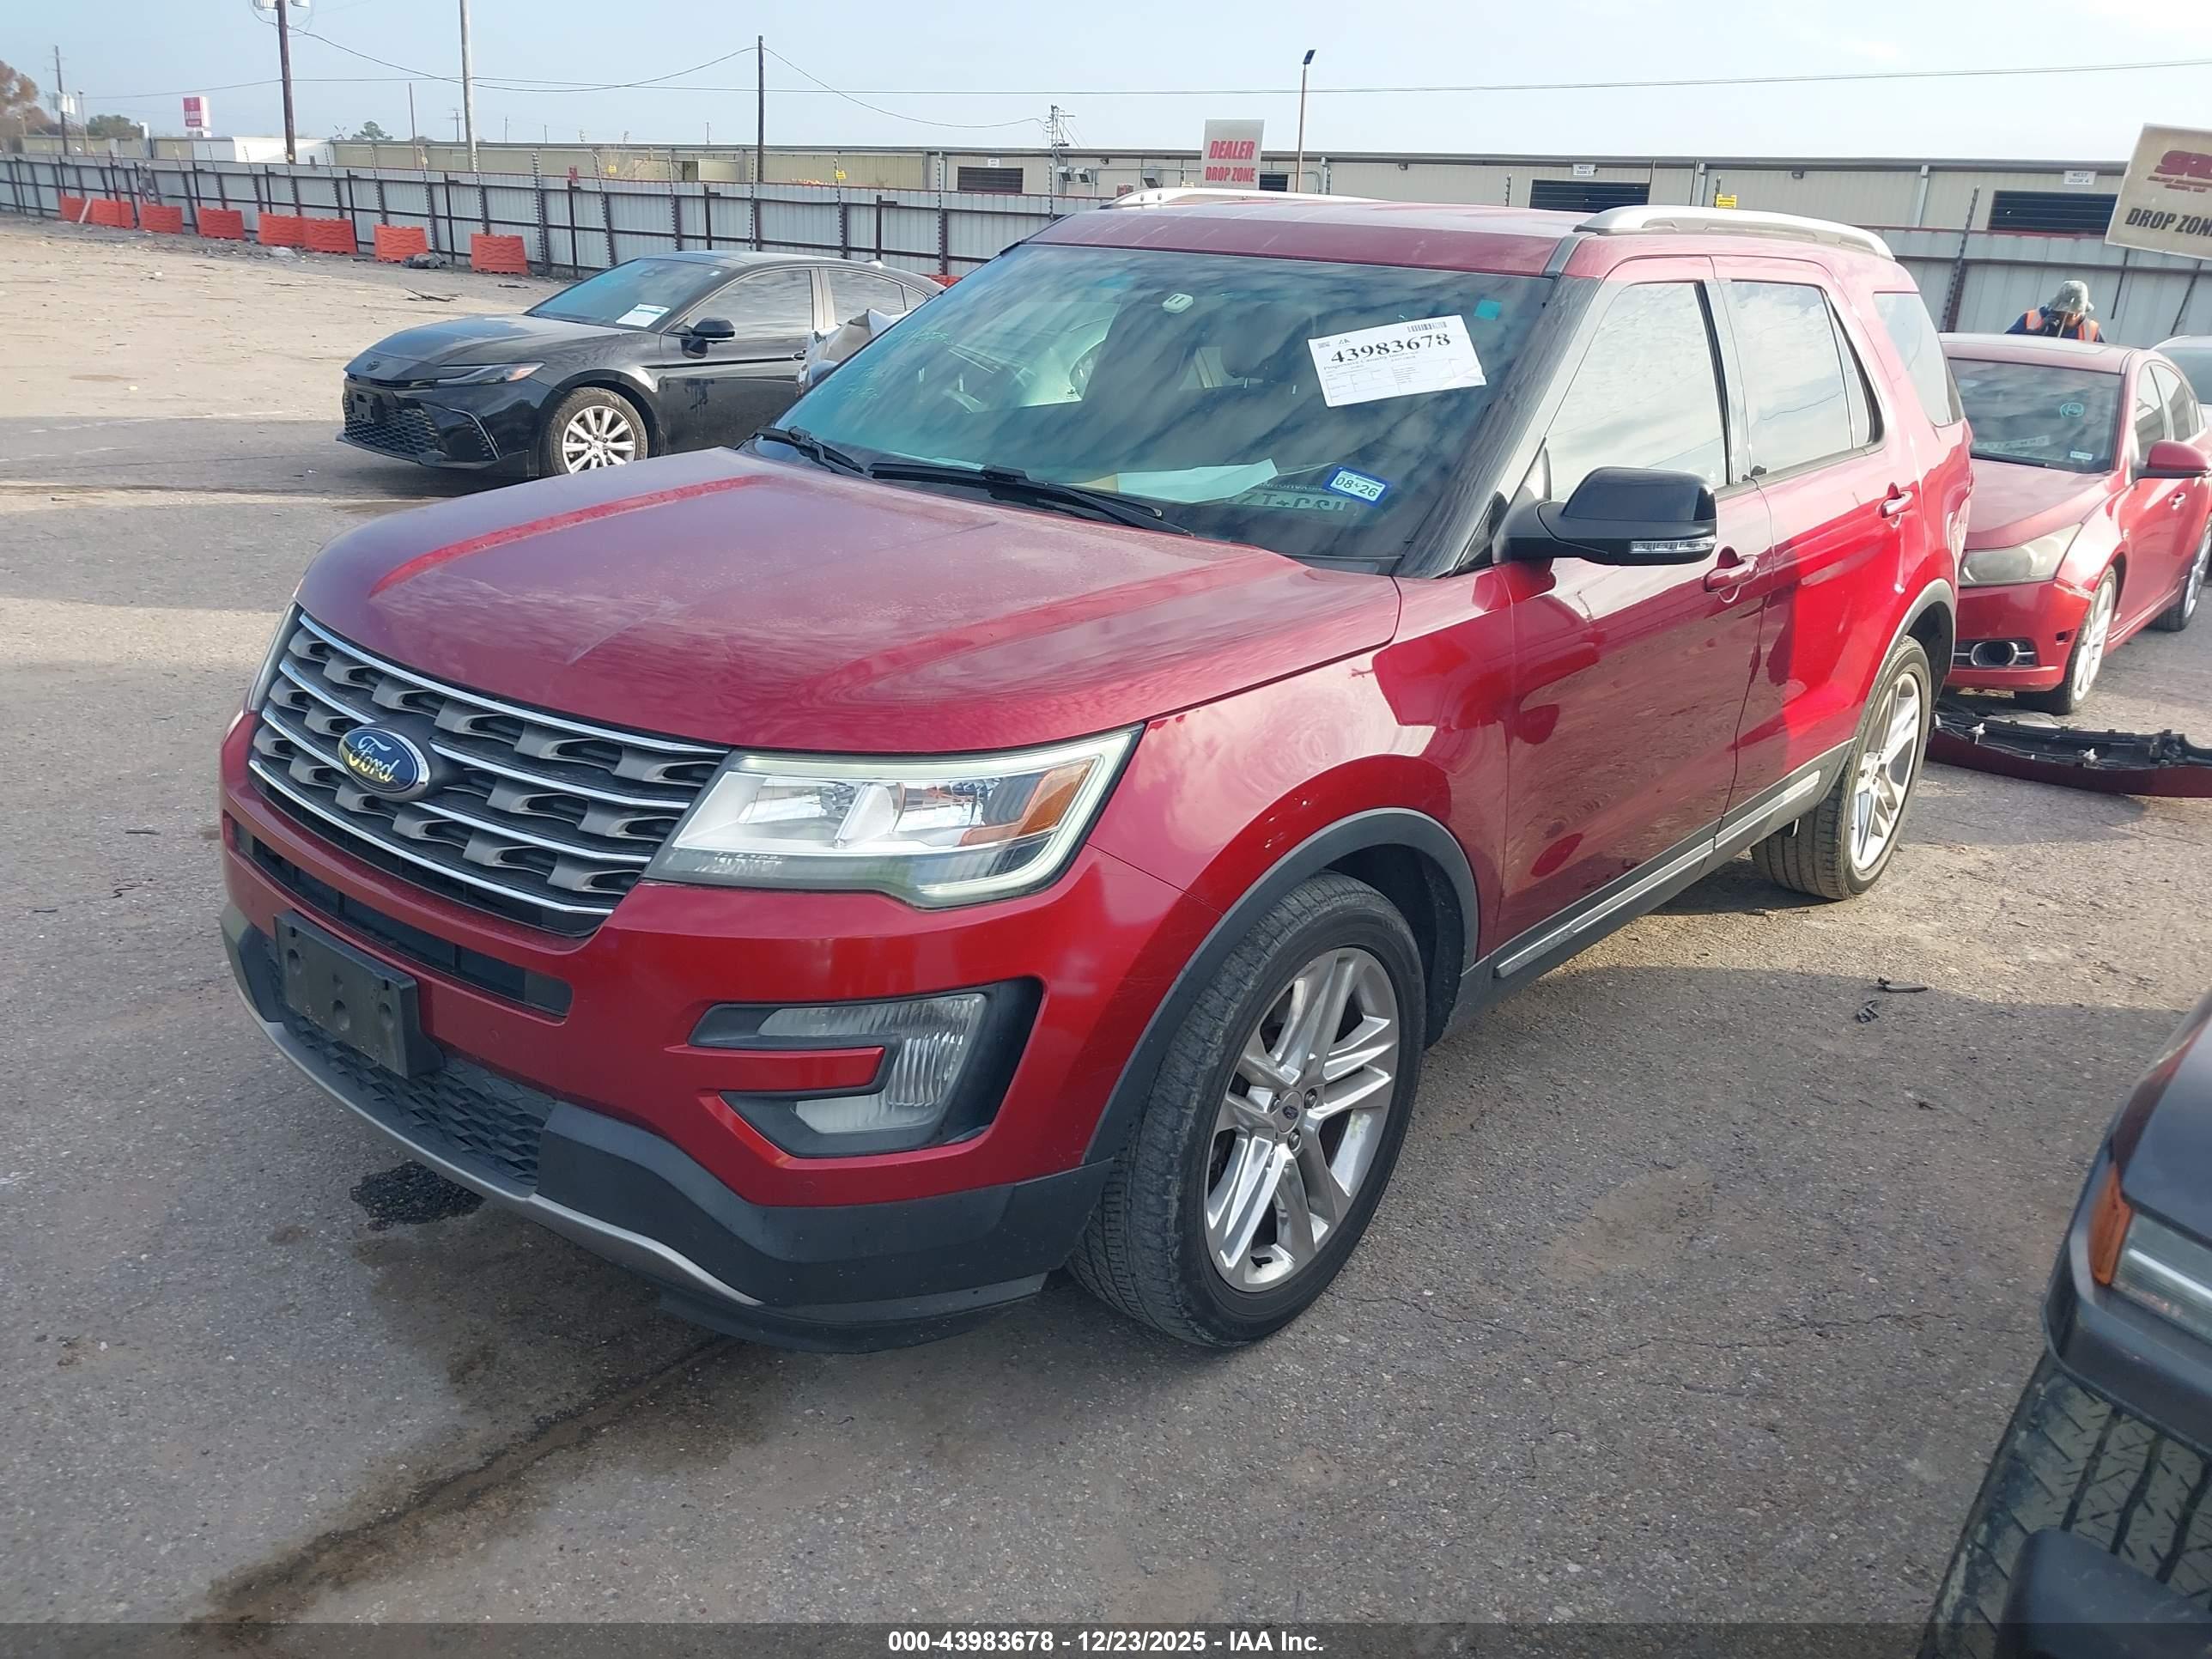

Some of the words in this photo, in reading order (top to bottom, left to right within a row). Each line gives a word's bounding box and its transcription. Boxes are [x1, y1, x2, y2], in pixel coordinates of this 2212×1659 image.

[1209, 141, 1255, 160] DEALER
[1206, 167, 1230, 181] DROP
[1231, 167, 1255, 182] ZONE
[2125, 208, 2177, 230] DROP
[1330, 333, 1451, 363] 43983678
[1335, 477, 1354, 489] 08
[1358, 484, 1379, 497] 26
[349, 736, 401, 782] Ford
